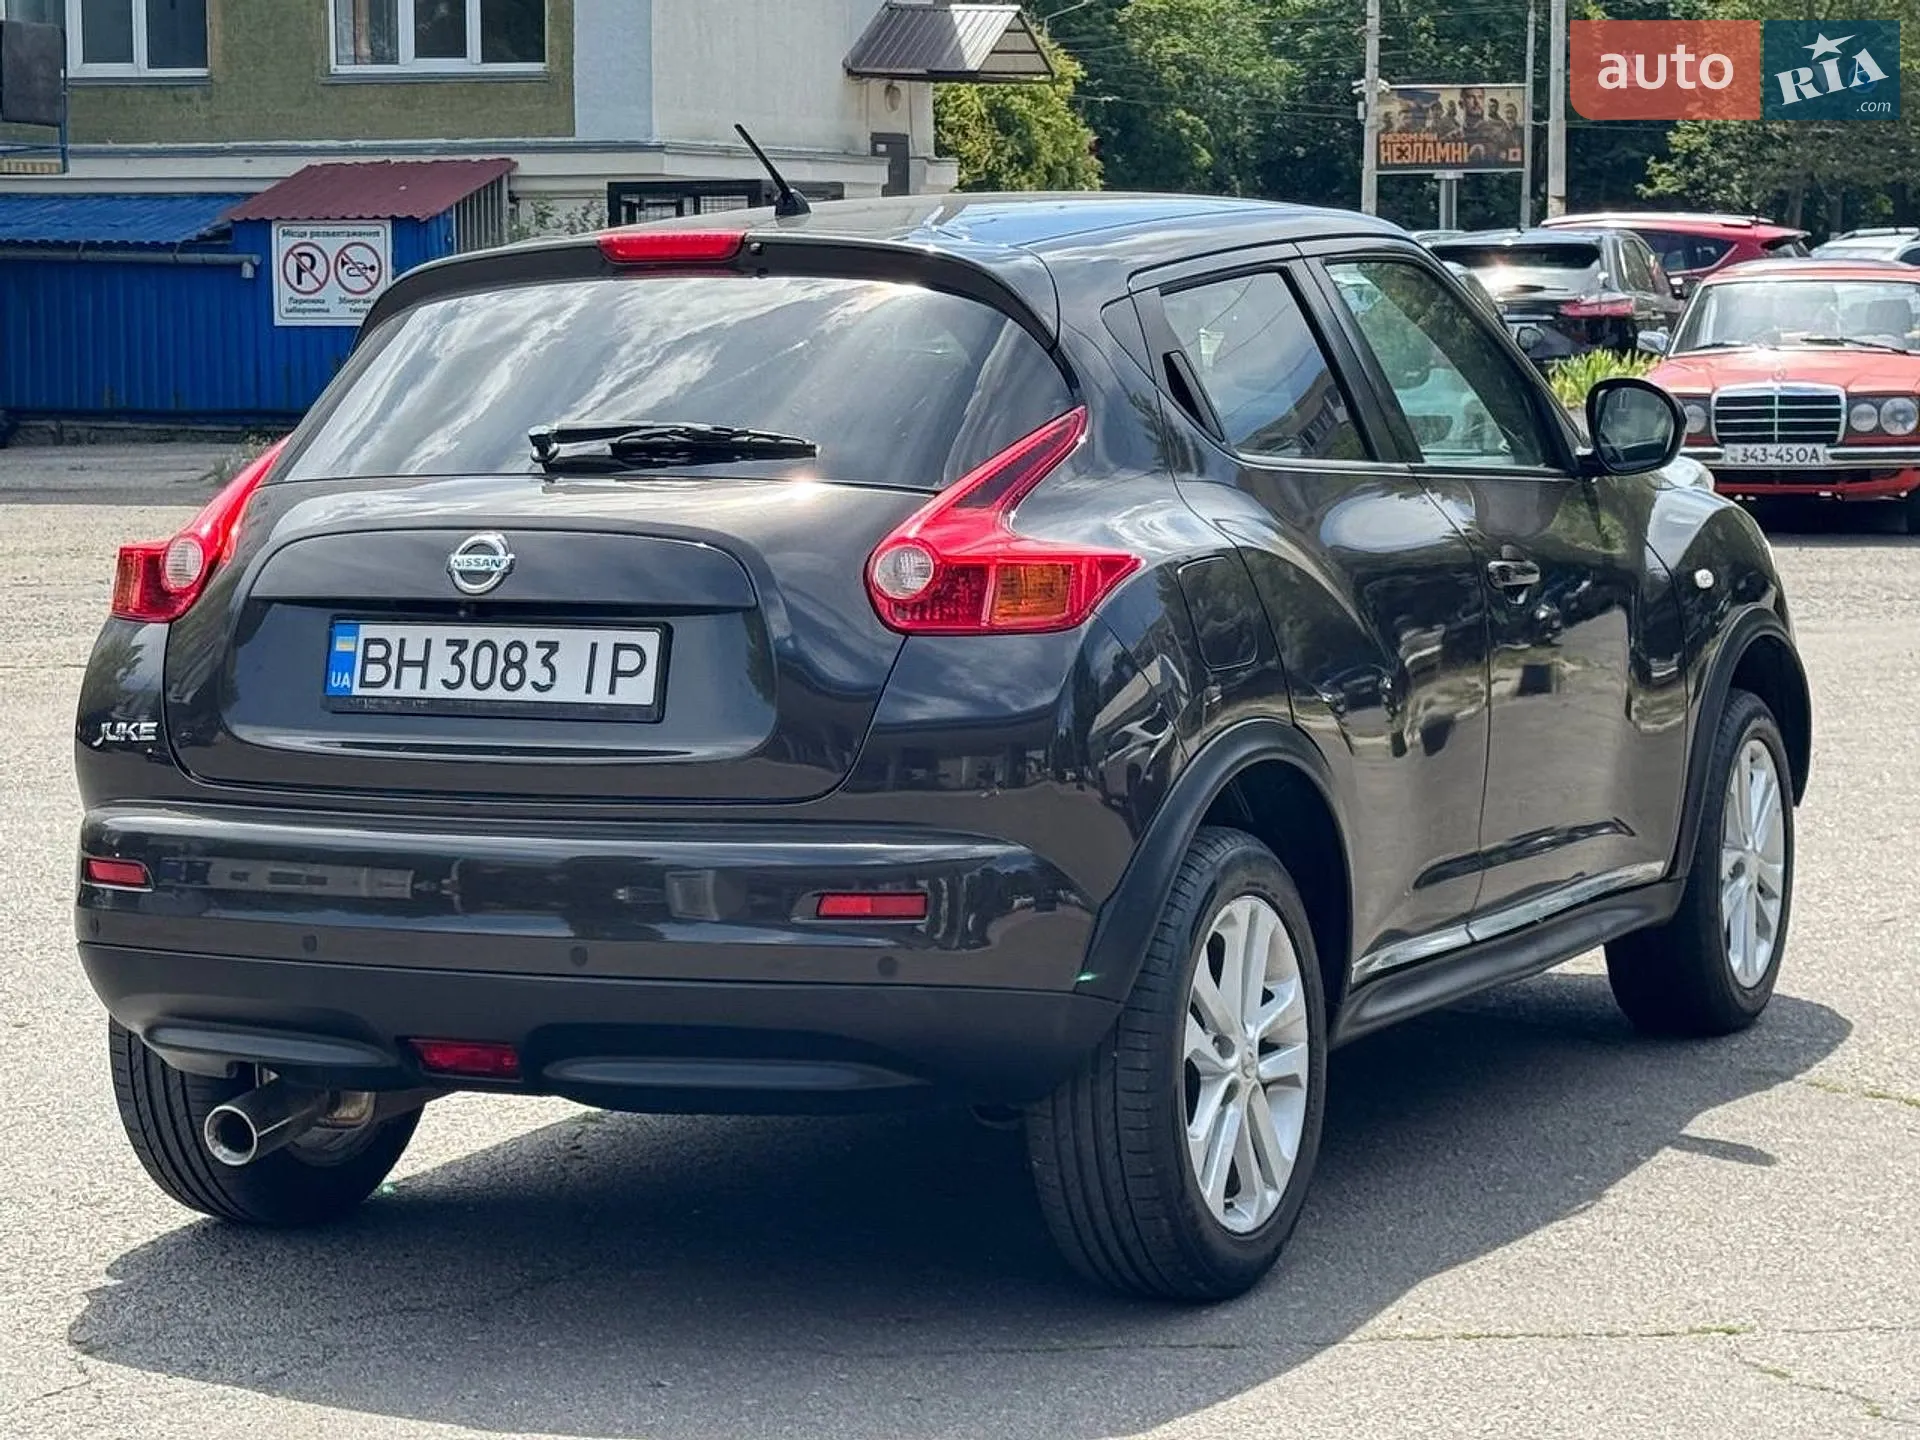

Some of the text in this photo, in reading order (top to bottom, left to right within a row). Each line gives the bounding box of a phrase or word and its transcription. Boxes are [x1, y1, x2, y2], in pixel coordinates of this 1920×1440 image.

[1380, 142, 1468, 164] НЕЗЛАМНІ
[453, 558, 502, 569] NISSAN
[359, 637, 432, 690] BH
[440, 639, 560, 693] 3083
[331, 671, 352, 688] UA
[92, 721, 159, 747] JUKE
